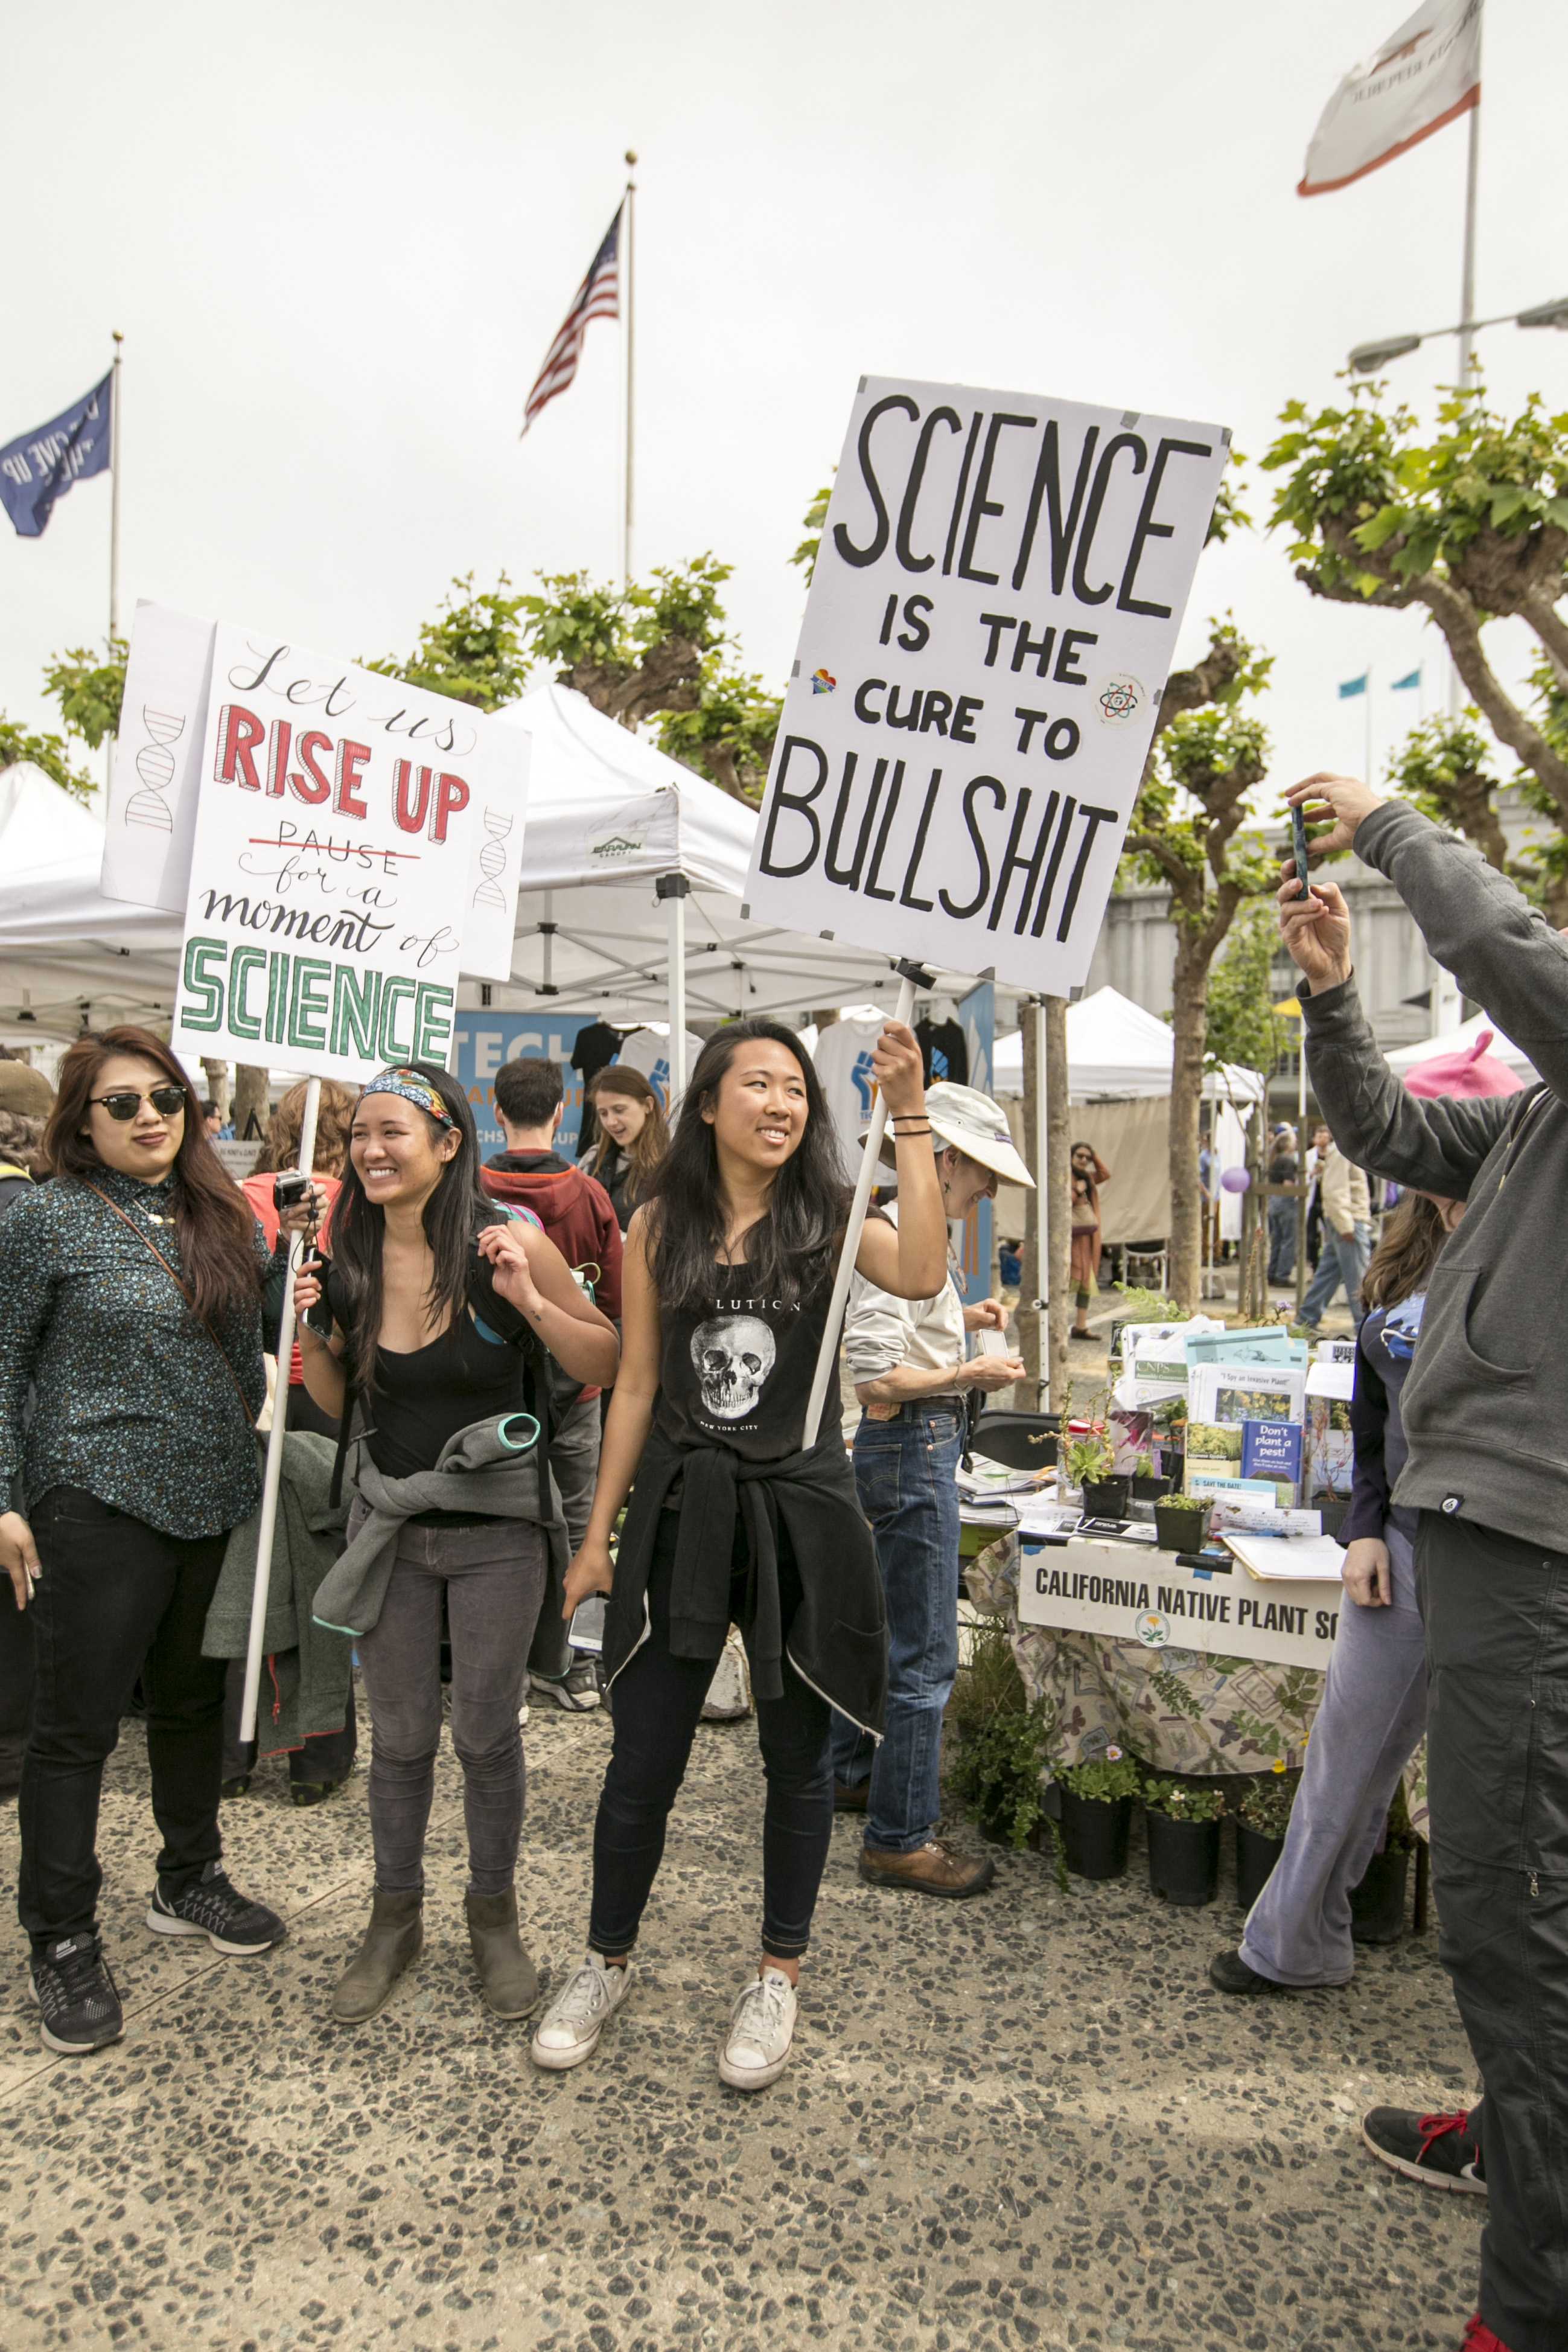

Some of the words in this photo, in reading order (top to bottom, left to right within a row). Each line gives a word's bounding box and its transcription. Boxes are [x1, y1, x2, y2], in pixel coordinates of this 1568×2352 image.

[833, 394, 1212, 619] SCIENCE
[879, 594, 934, 652] IS
[980, 613, 1098, 686] THE
[229, 640, 357, 717] Let
[368, 708, 477, 756] us
[855, 678, 984, 744] CURE
[1015, 706, 1080, 761] TO
[213, 704, 372, 820] RISE
[391, 758, 471, 845] UP
[238, 851, 337, 893] for
[346, 886, 397, 907] a
[279, 820, 400, 876] PAUSE
[759, 735, 1119, 943] BULLSHIT
[199, 889, 395, 953] moment
[400, 925, 460, 968] of
[181, 936, 455, 1069] SCIENCE
[1255, 1435, 1282, 1446] plant
[1259, 1448, 1286, 1457] pest!
[1260, 1425, 1289, 1437] Don't
[1036, 1567, 1149, 1609] CALIFORNIA
[1158, 1586, 1231, 1623] NATIVE
[1238, 1598, 1308, 1635] PLANT
